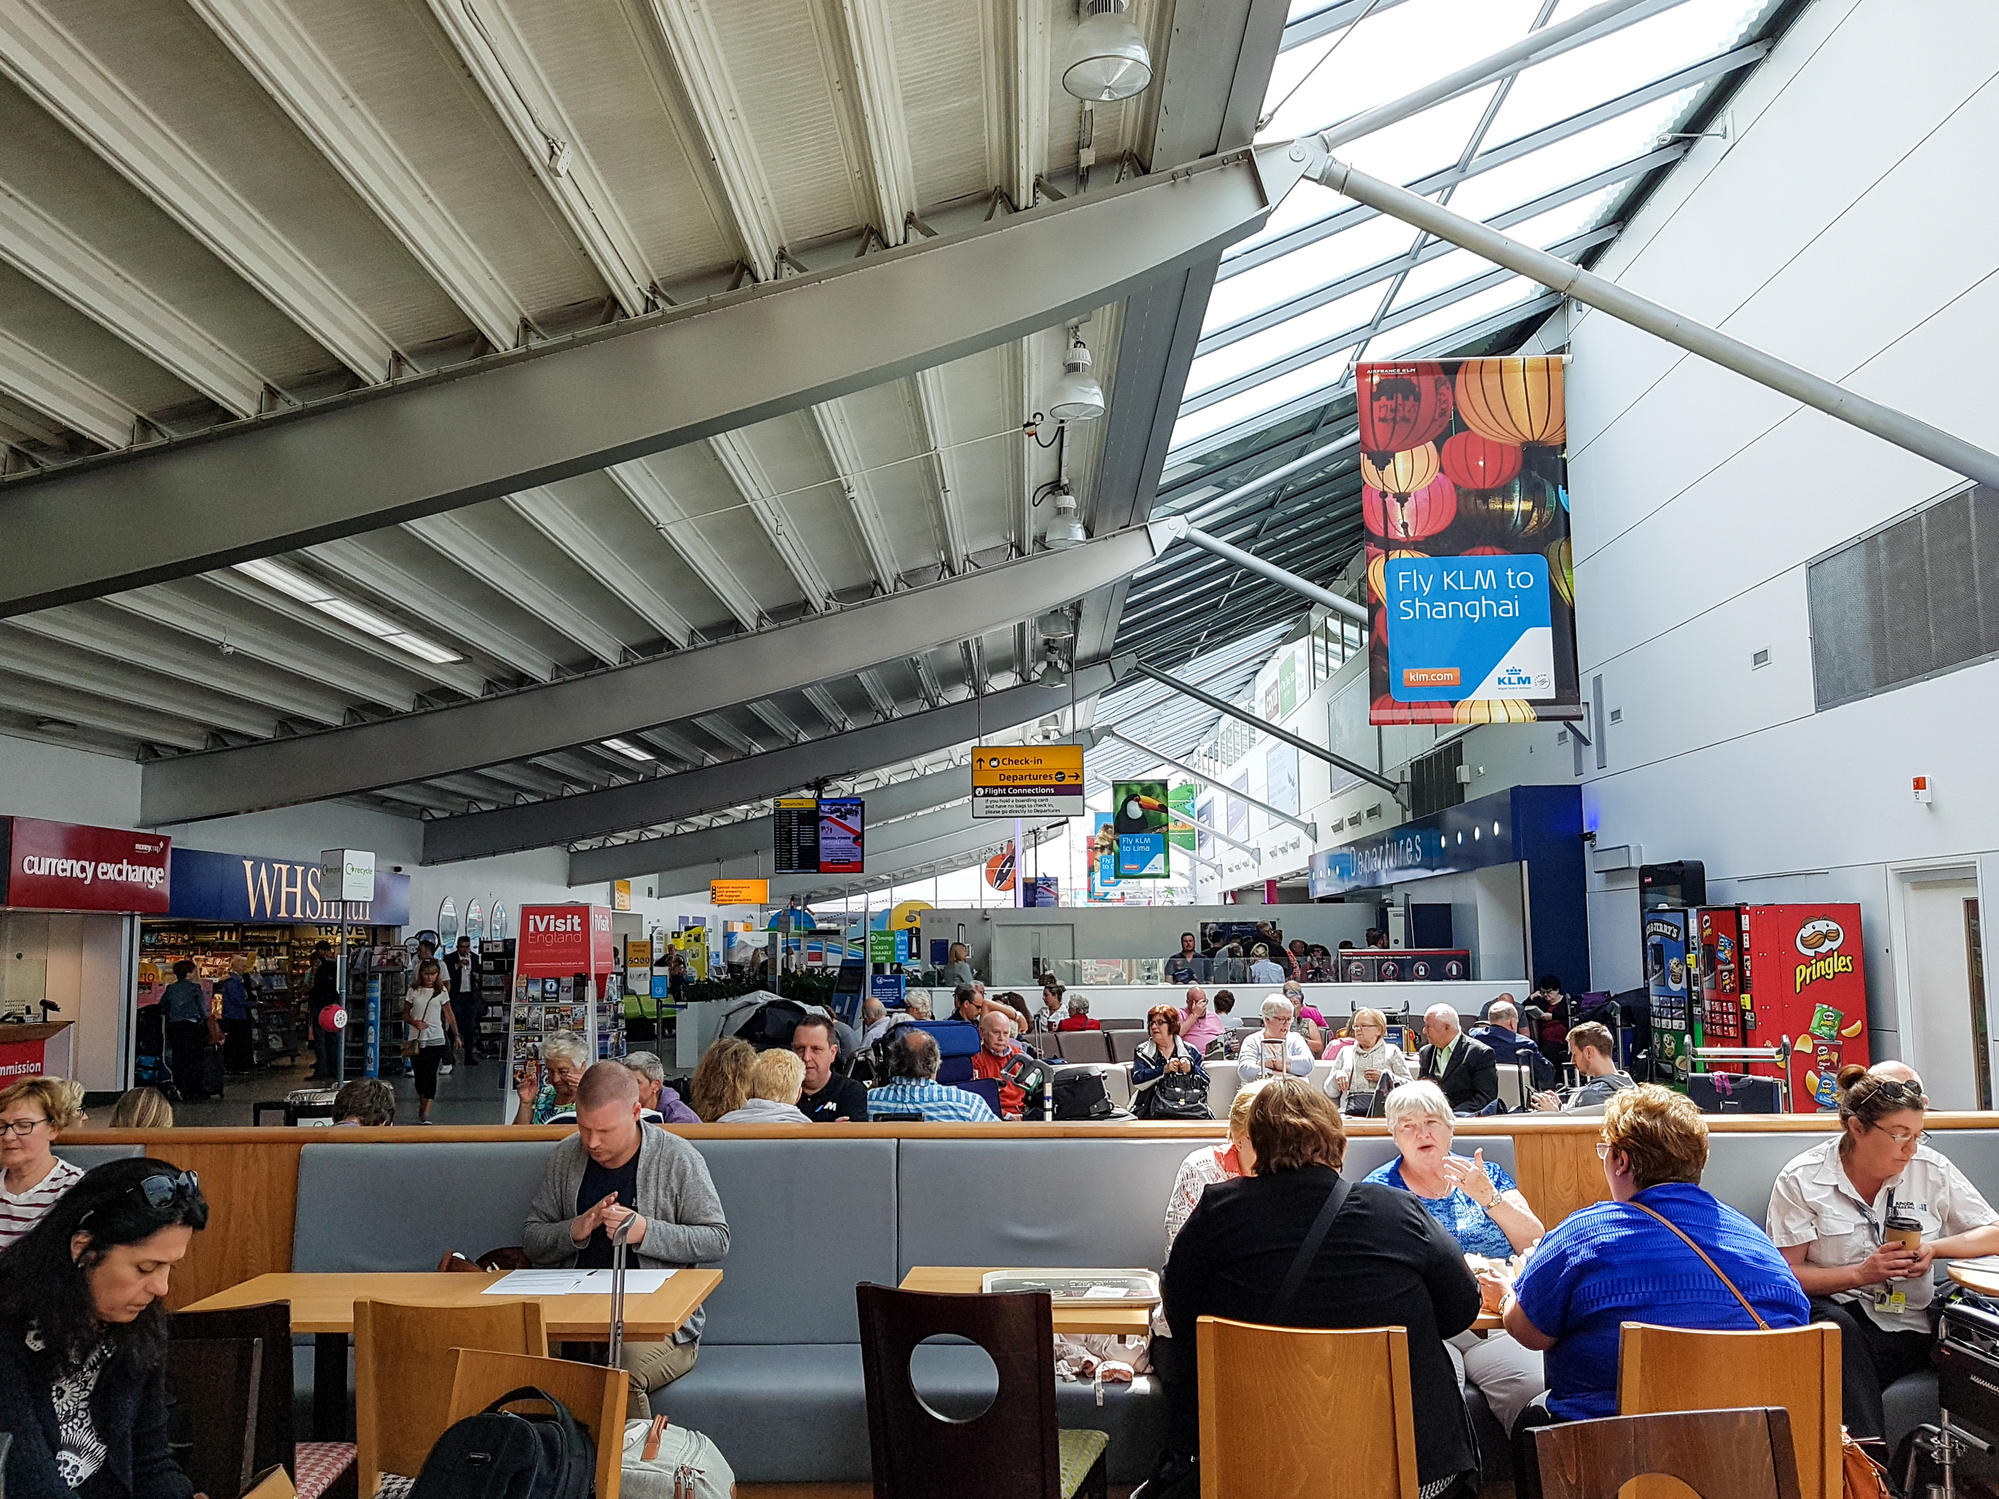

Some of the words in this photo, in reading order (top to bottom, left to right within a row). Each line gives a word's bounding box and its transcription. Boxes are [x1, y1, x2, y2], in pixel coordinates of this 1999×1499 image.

[1398, 569, 1433, 596] Fly
[1443, 569, 1497, 591] KLM
[1506, 568, 1534, 589] to
[1399, 595, 1520, 623] Shanghai
[1409, 672, 1454, 682] klm.com
[1497, 676, 1531, 685] KLM
[1001, 757, 1043, 766] Check-in
[999, 773, 1053, 783] Departures
[984, 787, 1007, 796] Flight
[1007, 787, 1055, 795] Connections
[1102, 857, 1111, 865] Fly
[1349, 834, 1423, 880] Departures
[22, 855, 96, 885] currency
[97, 858, 165, 889] exchange
[354, 866, 373, 876] recycle
[528, 914, 582, 932] iVisit
[1653, 922, 1678, 938] JERRY'S
[528, 931, 582, 947] England
[1795, 950, 1854, 994] Pringles
[823, 1101, 837, 1112] M
